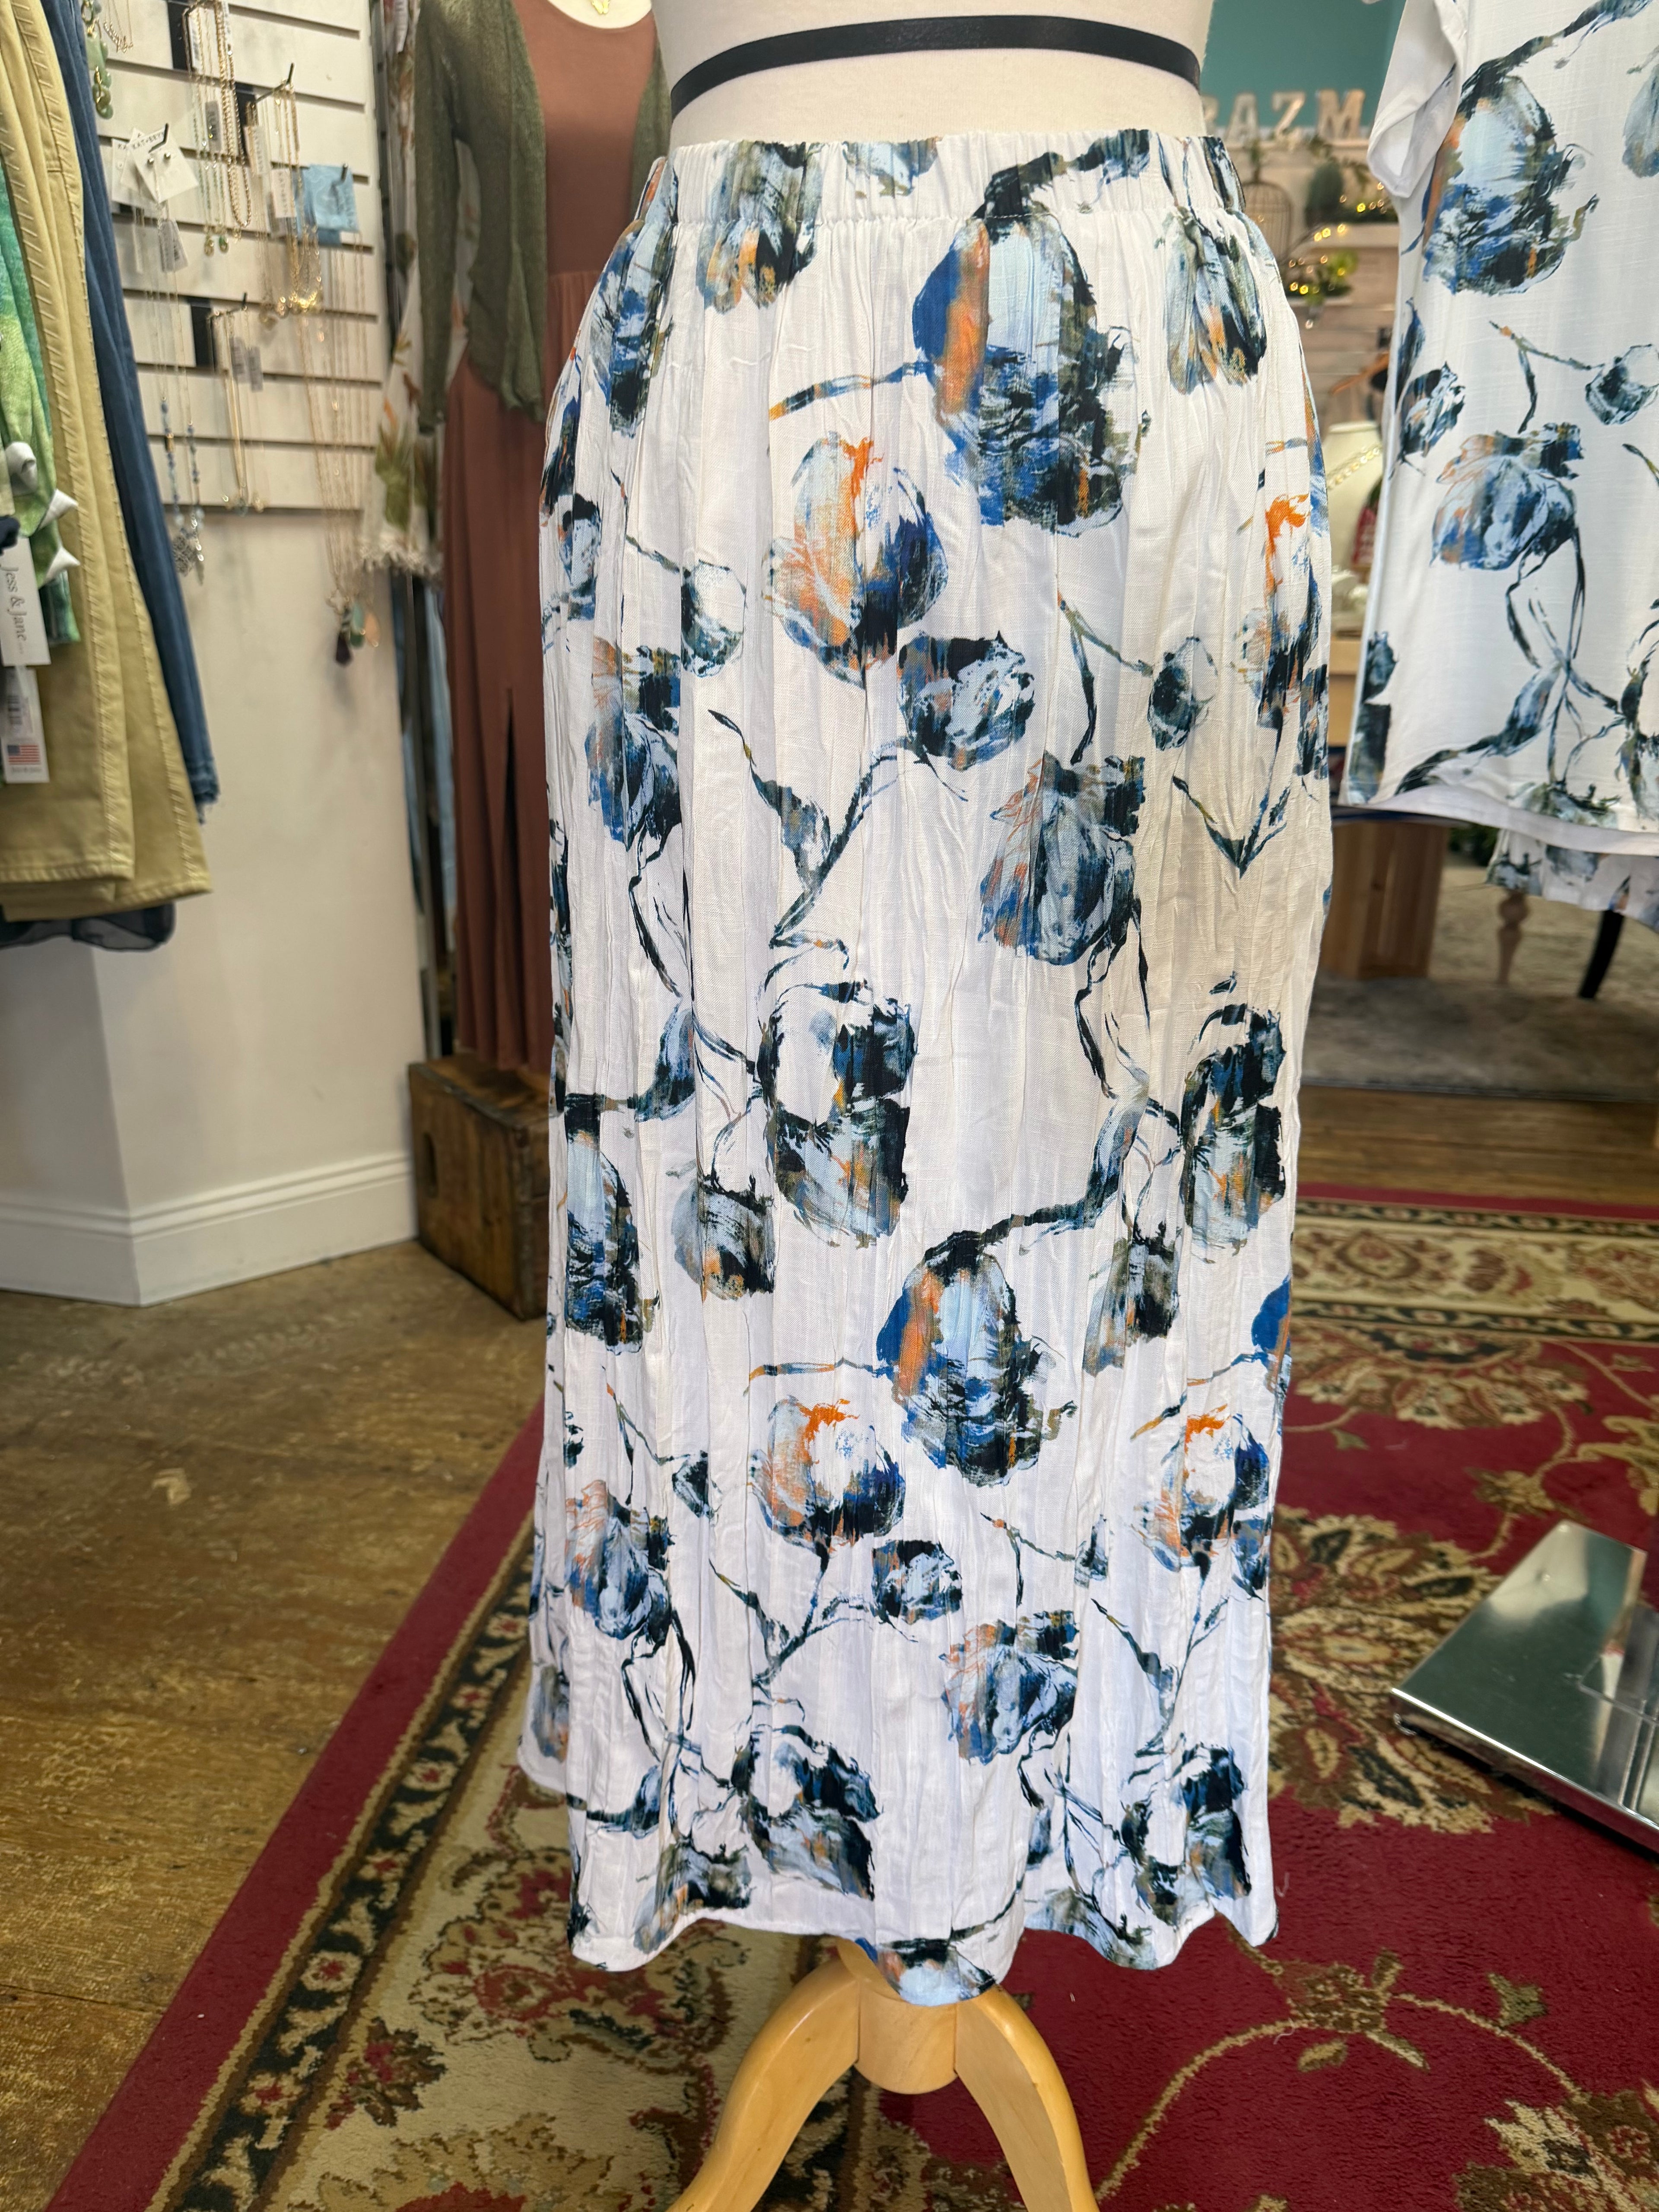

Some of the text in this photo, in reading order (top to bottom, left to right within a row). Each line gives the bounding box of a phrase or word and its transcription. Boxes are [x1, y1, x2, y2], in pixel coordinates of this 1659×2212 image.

[0, 564, 27, 641] Jess & Jane
